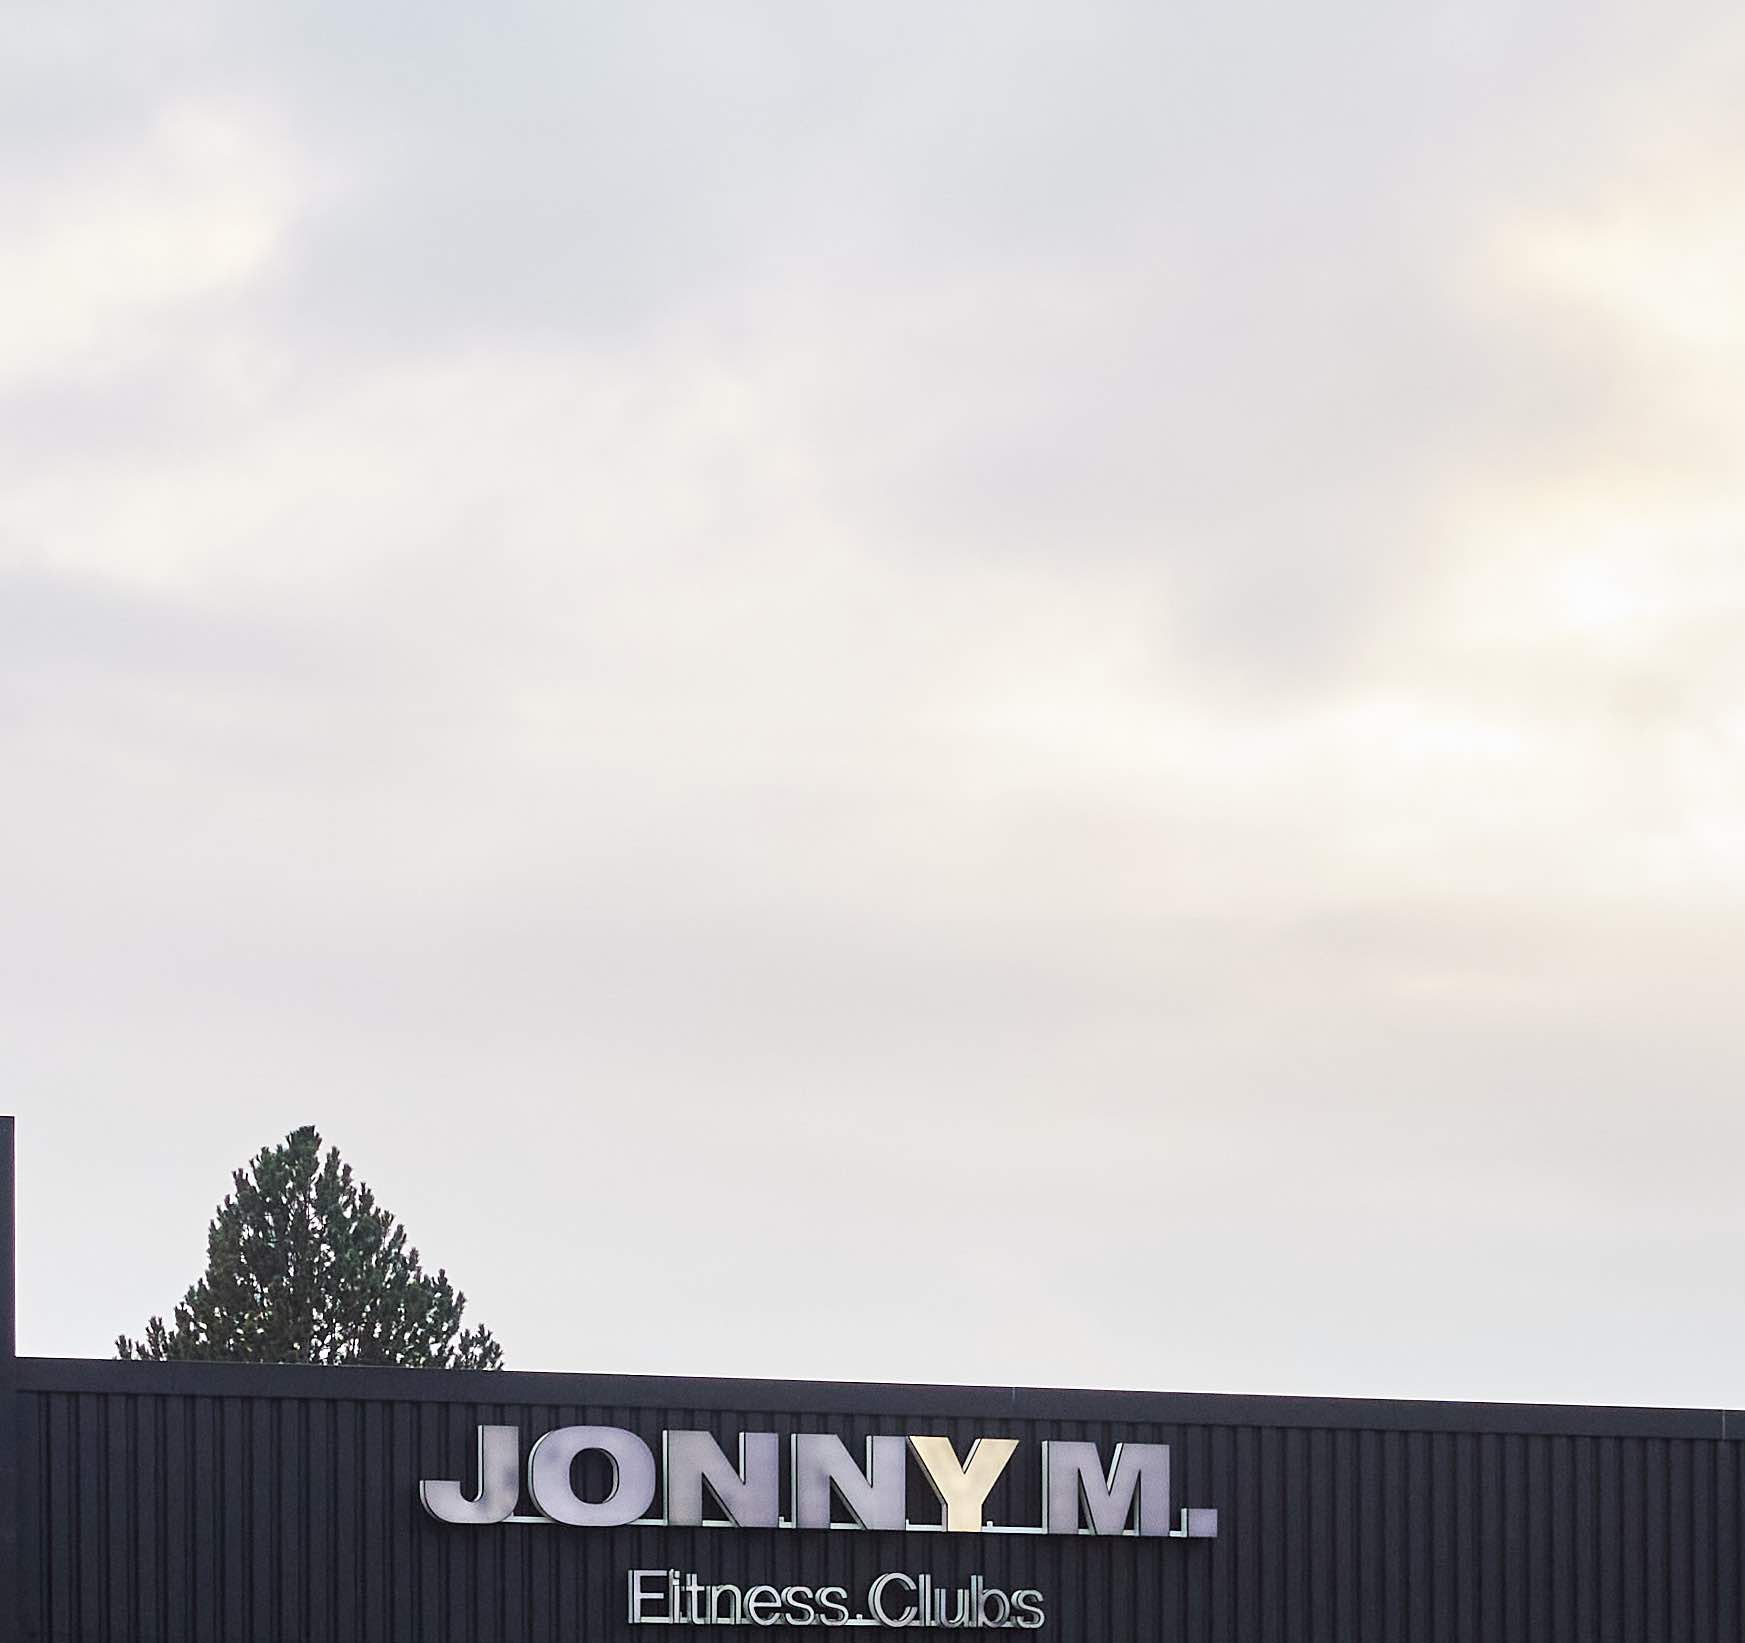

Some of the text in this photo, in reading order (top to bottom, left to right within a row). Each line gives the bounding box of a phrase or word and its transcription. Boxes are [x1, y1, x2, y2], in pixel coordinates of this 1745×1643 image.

[419, 1425, 1219, 1538] JONNY M.
[627, 1568, 1045, 1631] Fitness Clubs
